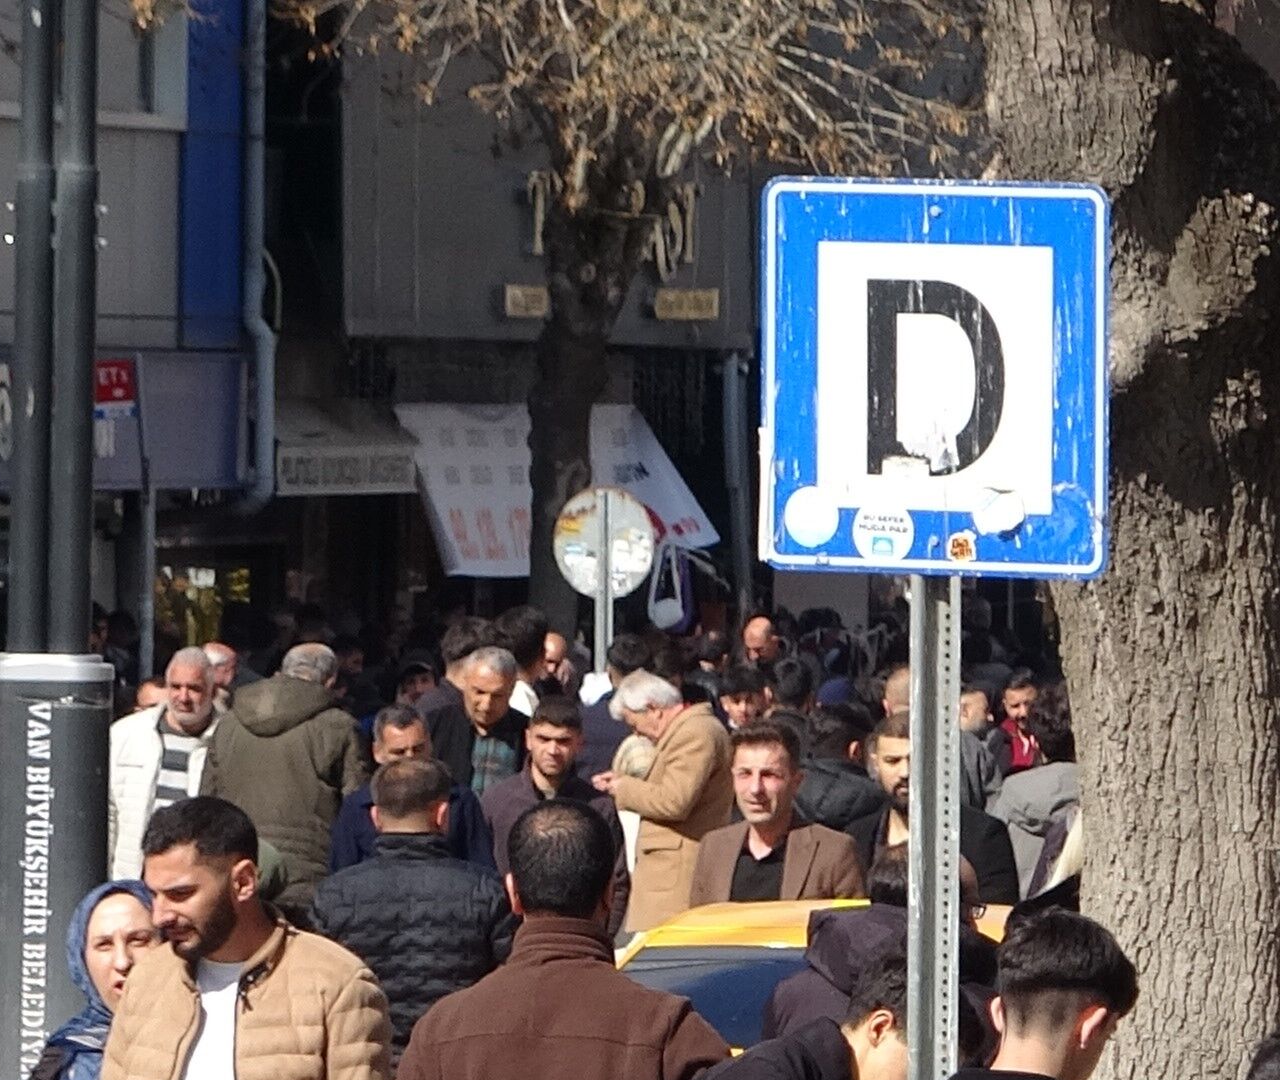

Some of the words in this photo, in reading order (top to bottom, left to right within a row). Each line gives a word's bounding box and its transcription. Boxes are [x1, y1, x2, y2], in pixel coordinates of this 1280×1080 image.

[867, 278, 1005, 477] D
[27, 701, 52, 760] VAN
[19, 765, 55, 936] BÜYÜKŞEHİR
